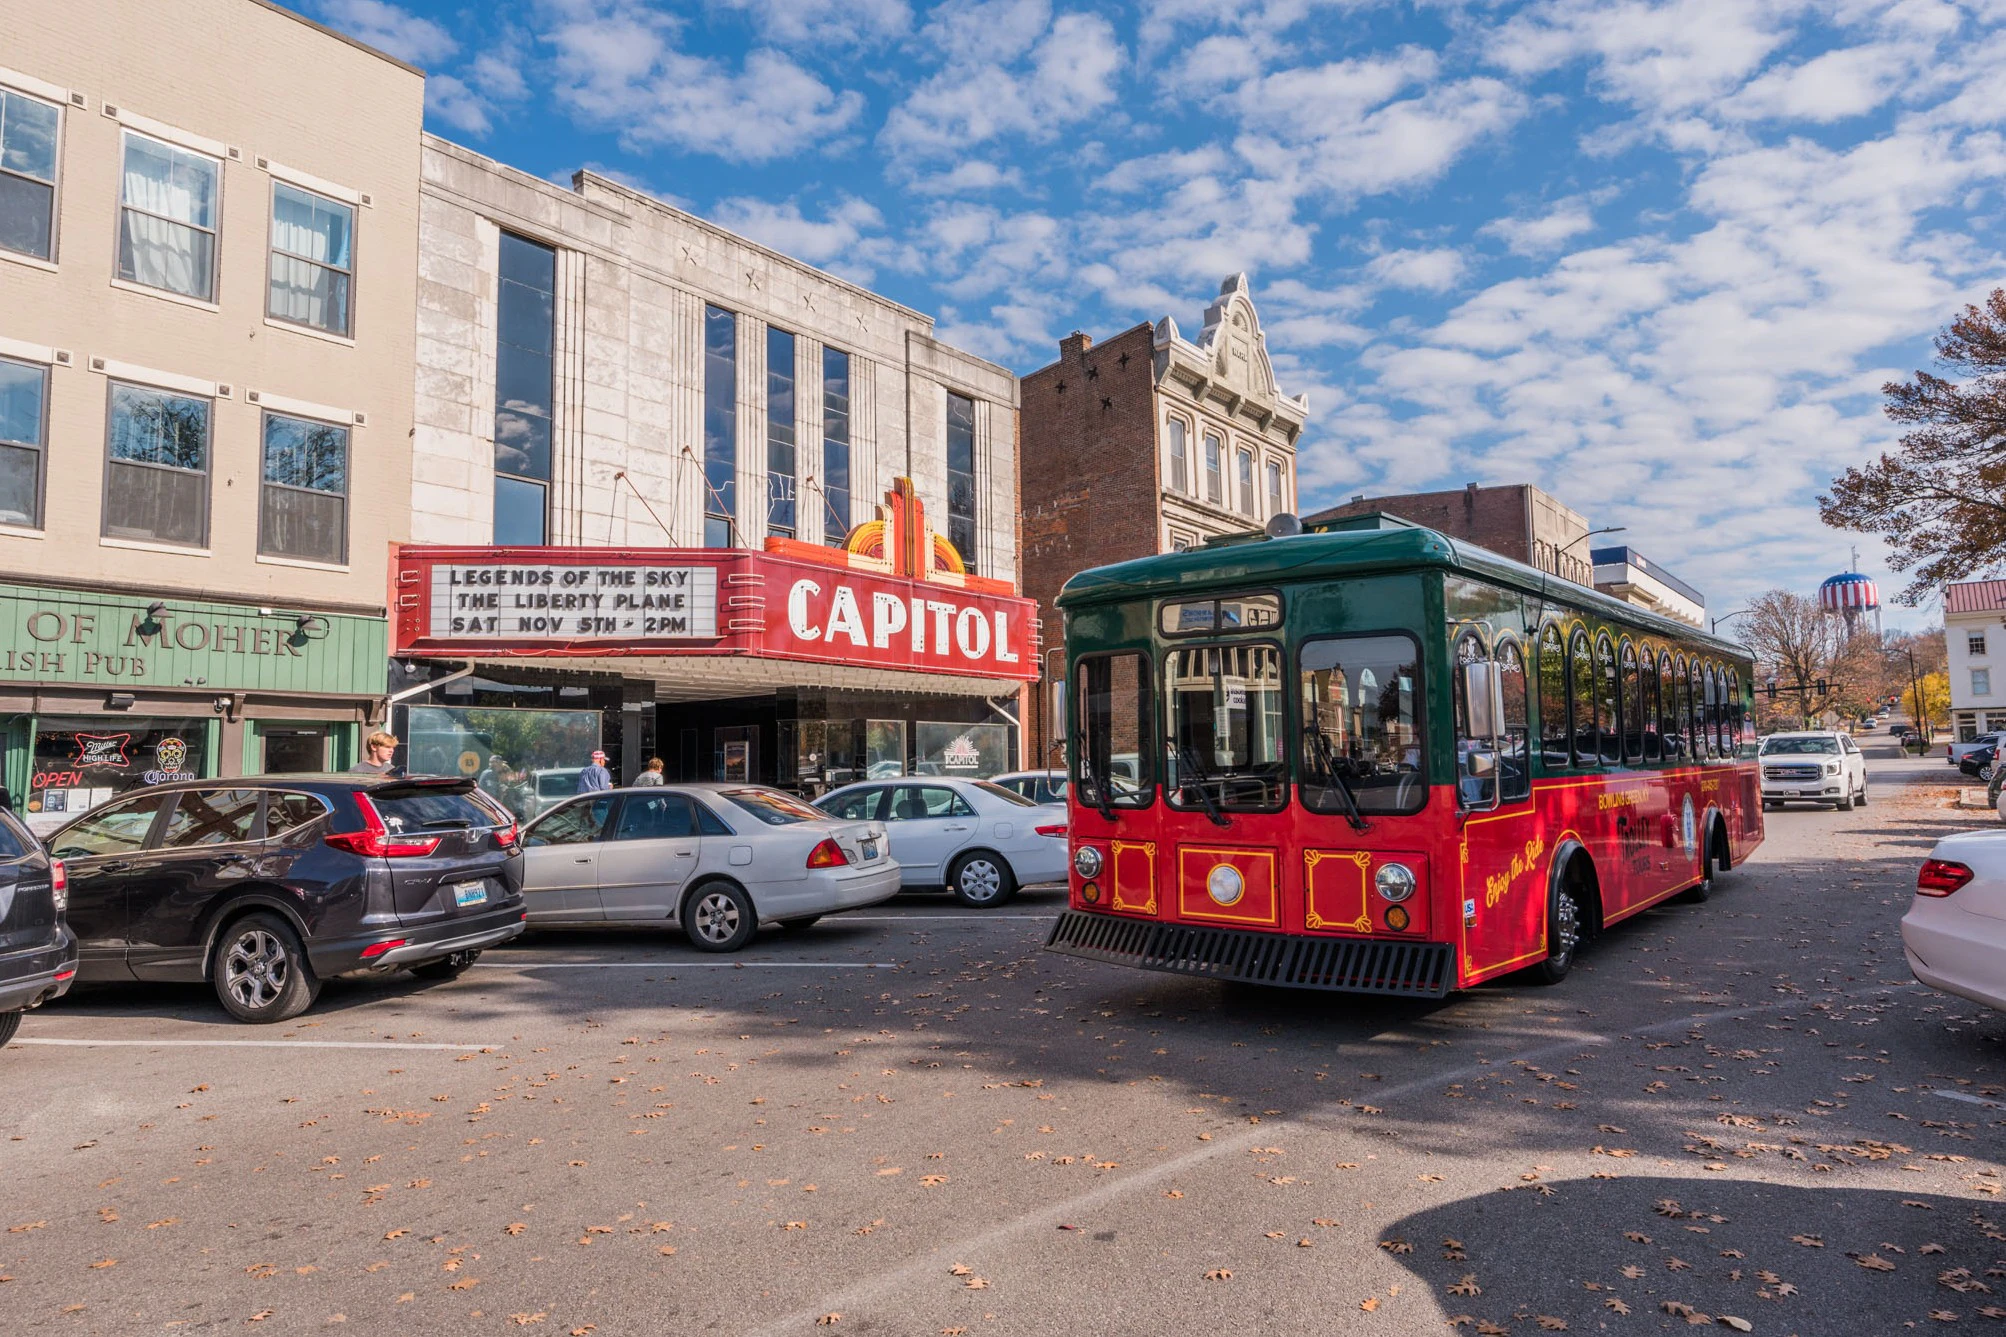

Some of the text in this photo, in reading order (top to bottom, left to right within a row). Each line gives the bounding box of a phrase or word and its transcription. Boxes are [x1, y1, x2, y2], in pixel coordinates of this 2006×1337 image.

[451, 570, 688, 585] LEGENDS OF THE SKY
[458, 593, 685, 608] THE LIBERTY PLANE
[452, 616, 498, 632] SAT
[519, 616, 564, 632] NOV
[580, 616, 617, 632] 5TH
[646, 616, 686, 632] 2PM
[788, 579, 1018, 663] CAPITOL
[27, 611, 303, 658] OF MOHER
[0, 650, 147, 677] ISH PUB
[86, 741, 117, 754] Miller
[949, 754, 979, 765] CAPITOL
[32, 770, 195, 788] OPEN Corona
[1598, 791, 1625, 810] BOWLING
[1486, 834, 1544, 908] Enjoy the Ride
